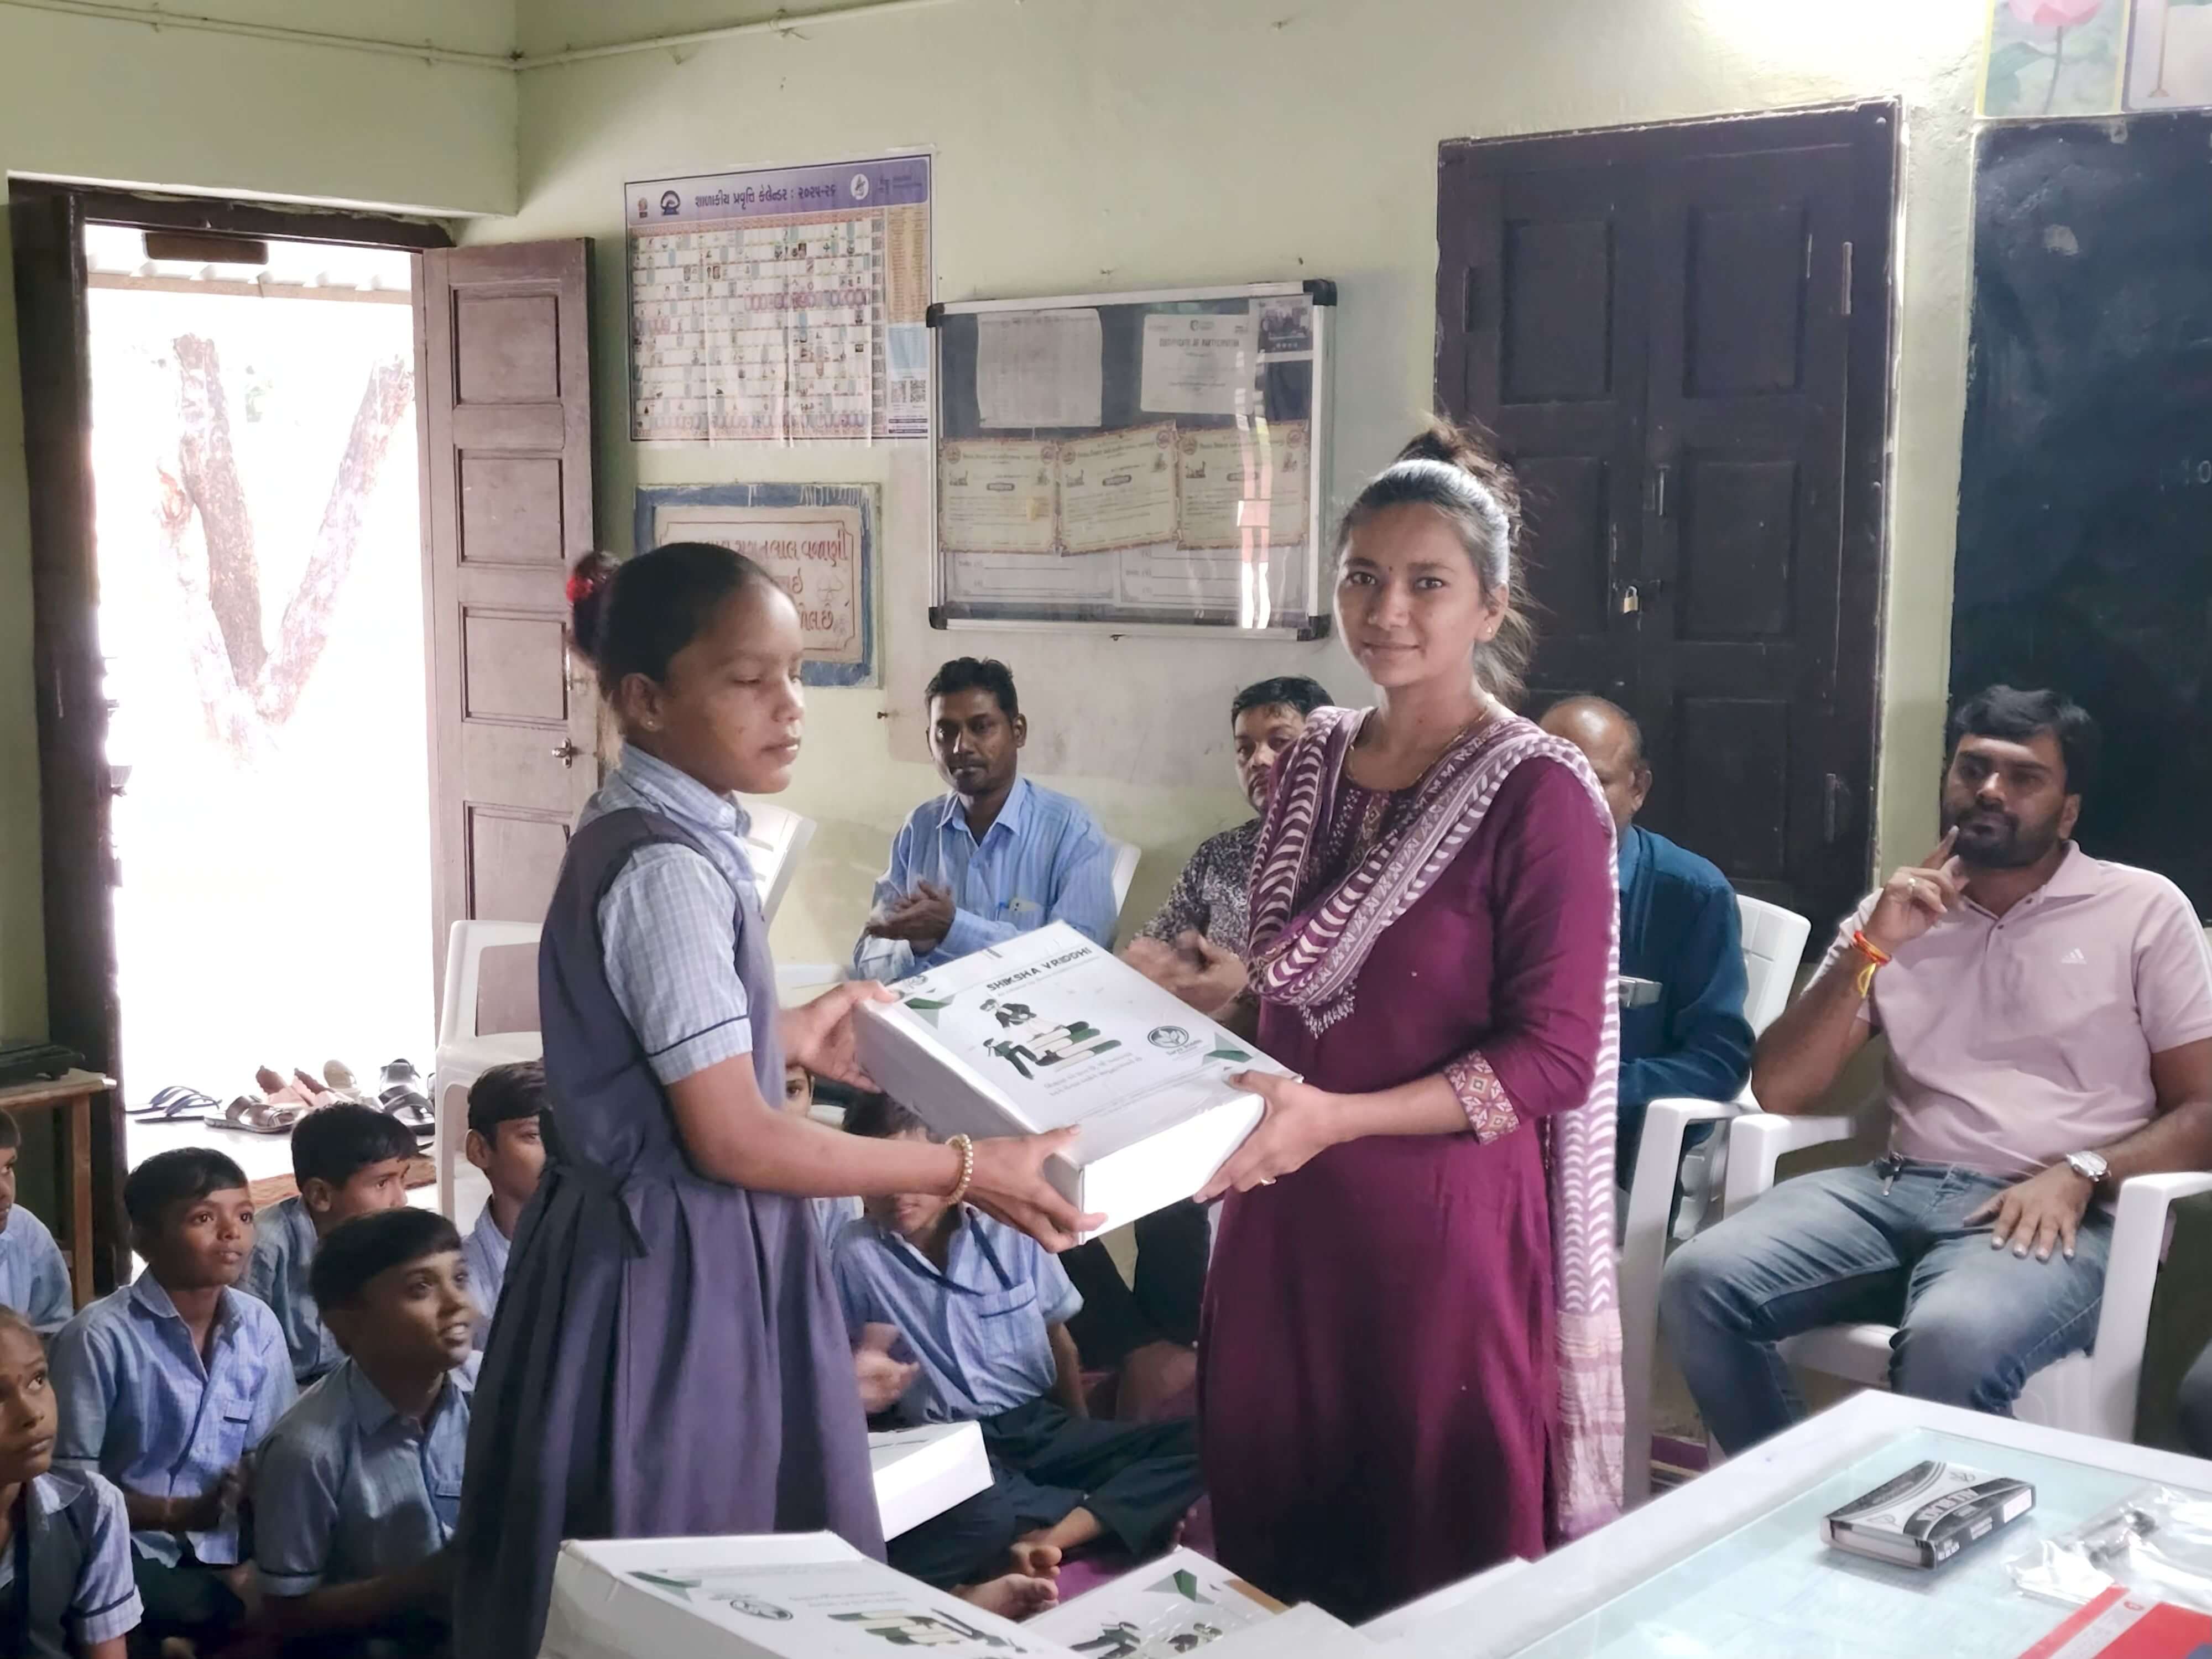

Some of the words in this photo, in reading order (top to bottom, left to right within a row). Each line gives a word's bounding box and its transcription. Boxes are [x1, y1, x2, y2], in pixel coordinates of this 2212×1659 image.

[695, 189, 730, 208] શાળાકીય
[986, 968, 1042, 991] SHIKSHA
[1040, 947, 1093, 969] VRIDDHI
